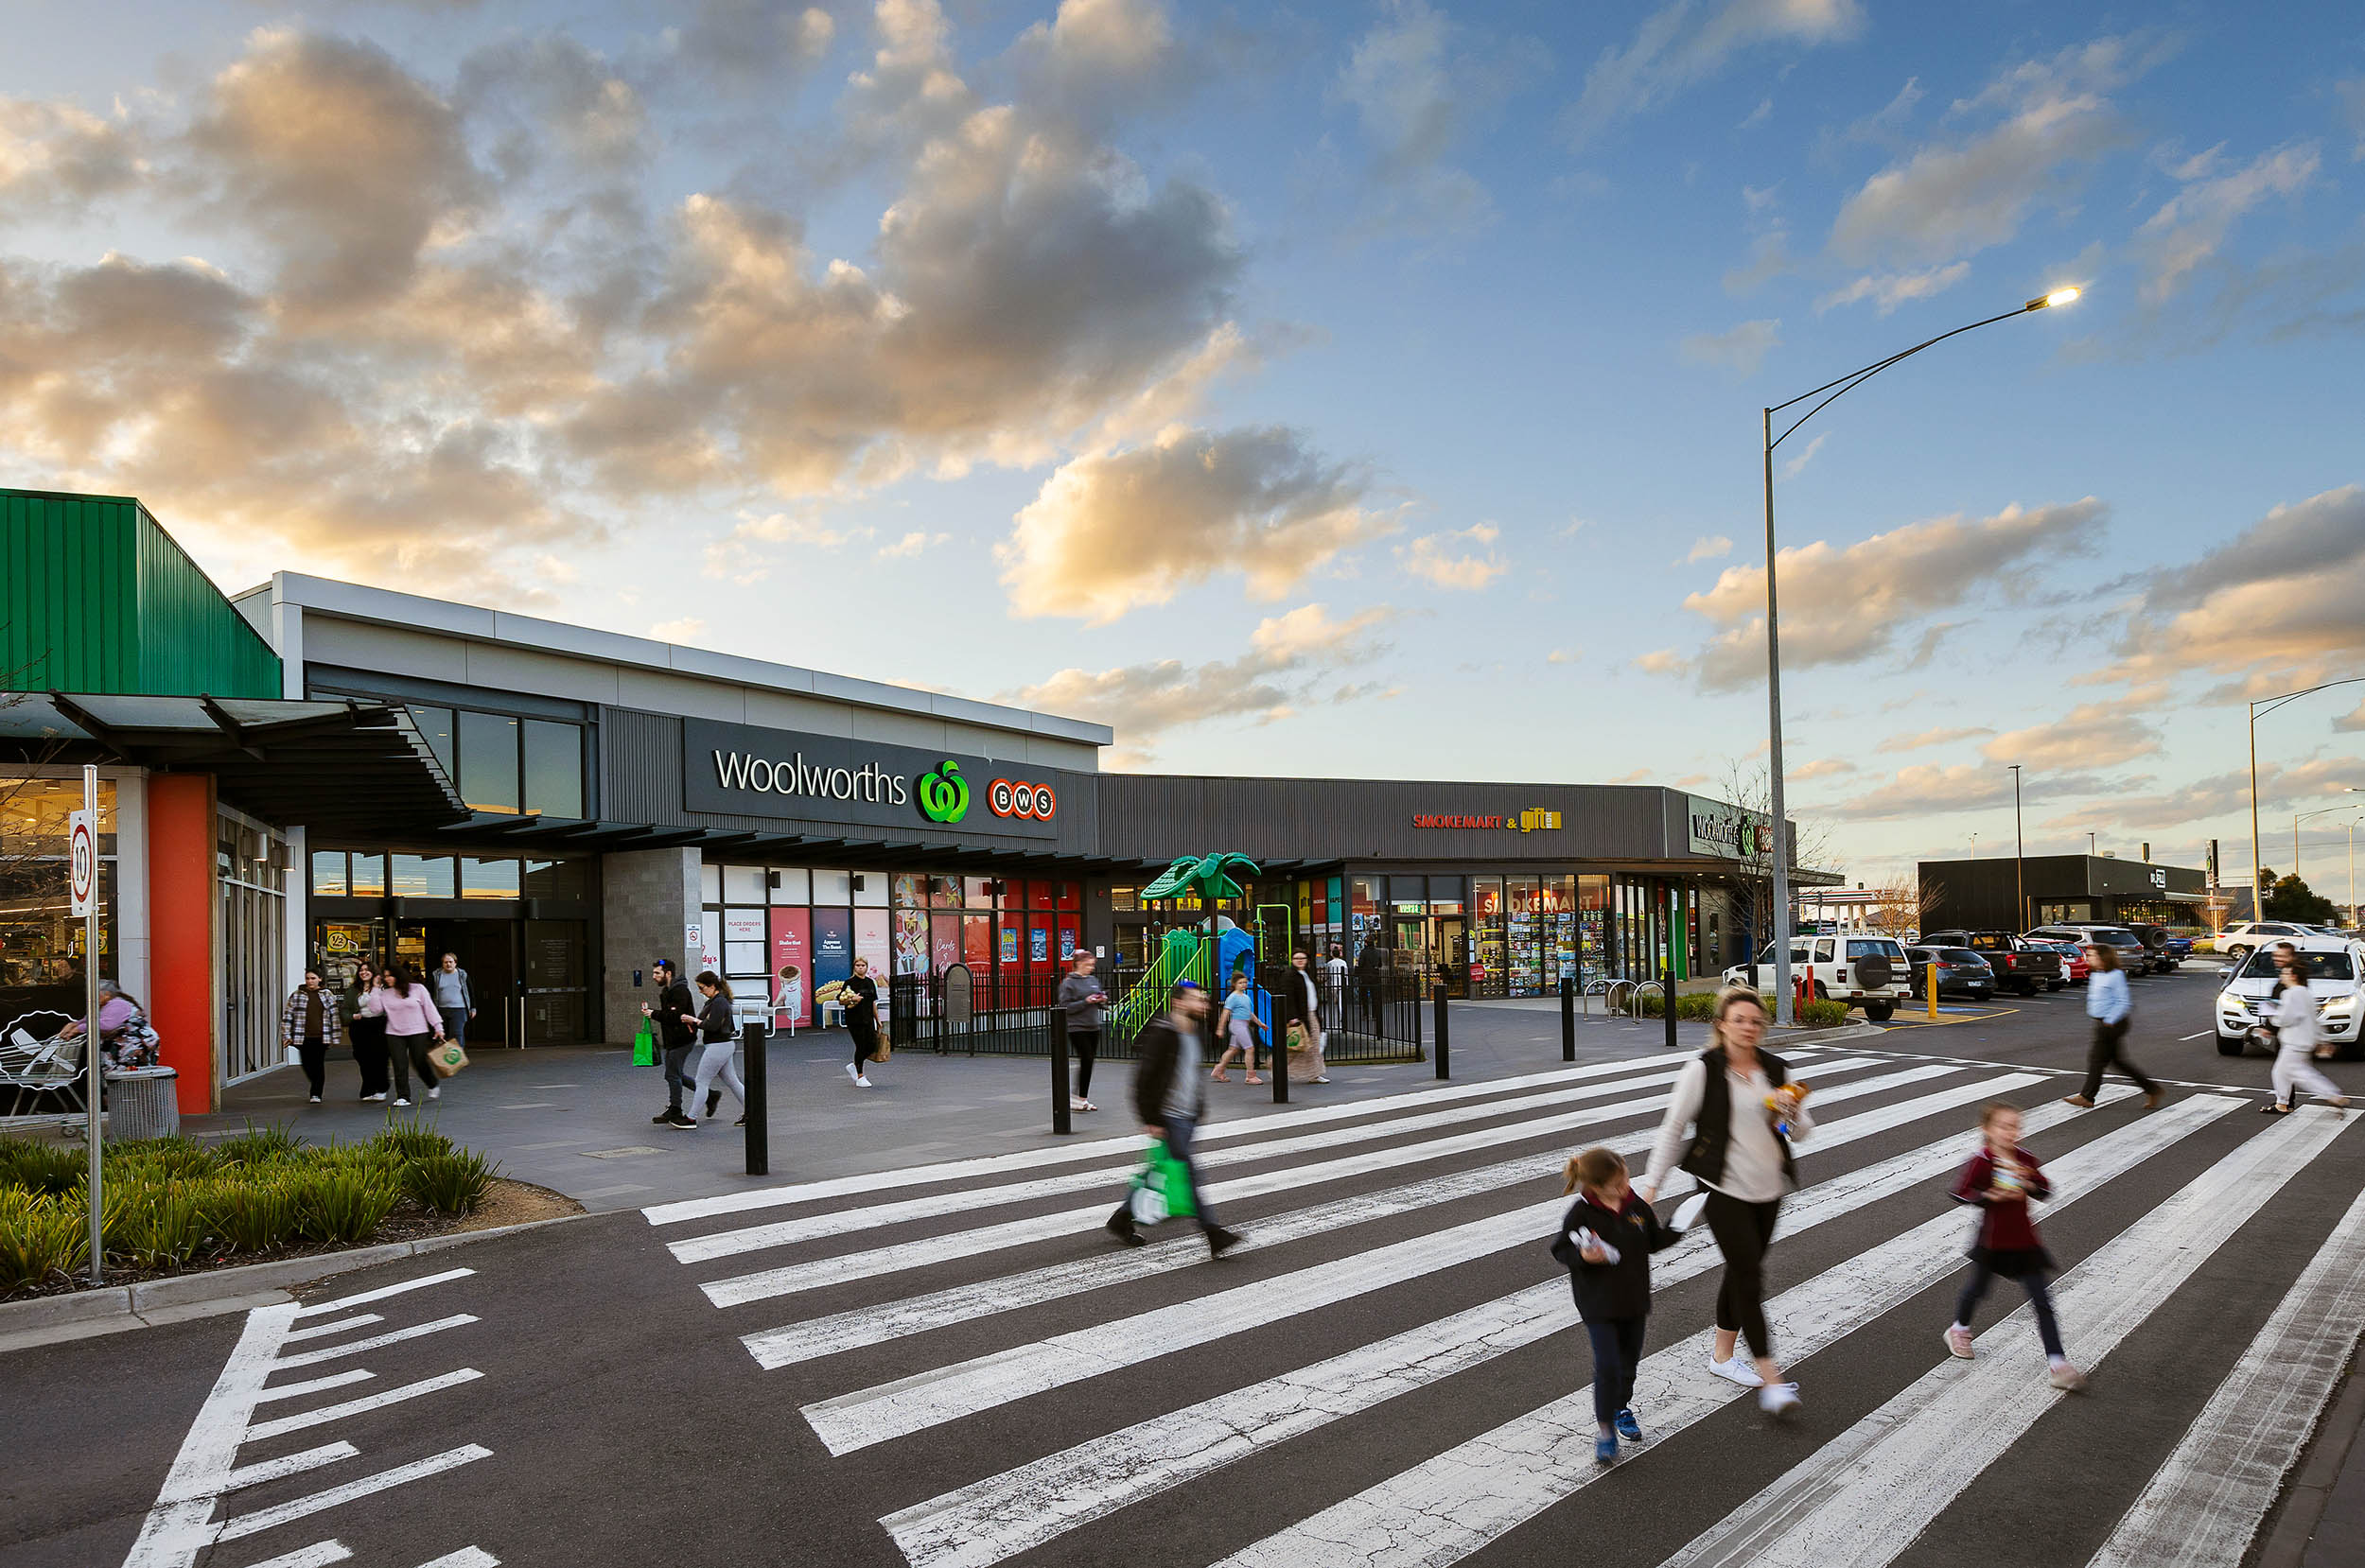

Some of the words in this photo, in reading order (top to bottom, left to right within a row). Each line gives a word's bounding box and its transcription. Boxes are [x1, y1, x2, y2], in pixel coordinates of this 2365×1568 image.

[714, 749, 907, 805] Woolworths
[1412, 814, 1502, 829] SMOKEMART
[1506, 817, 1517, 829] &
[1520, 807, 1547, 833] gift
[76, 845, 87, 882] 10
[702, 954, 717, 964] dy's
